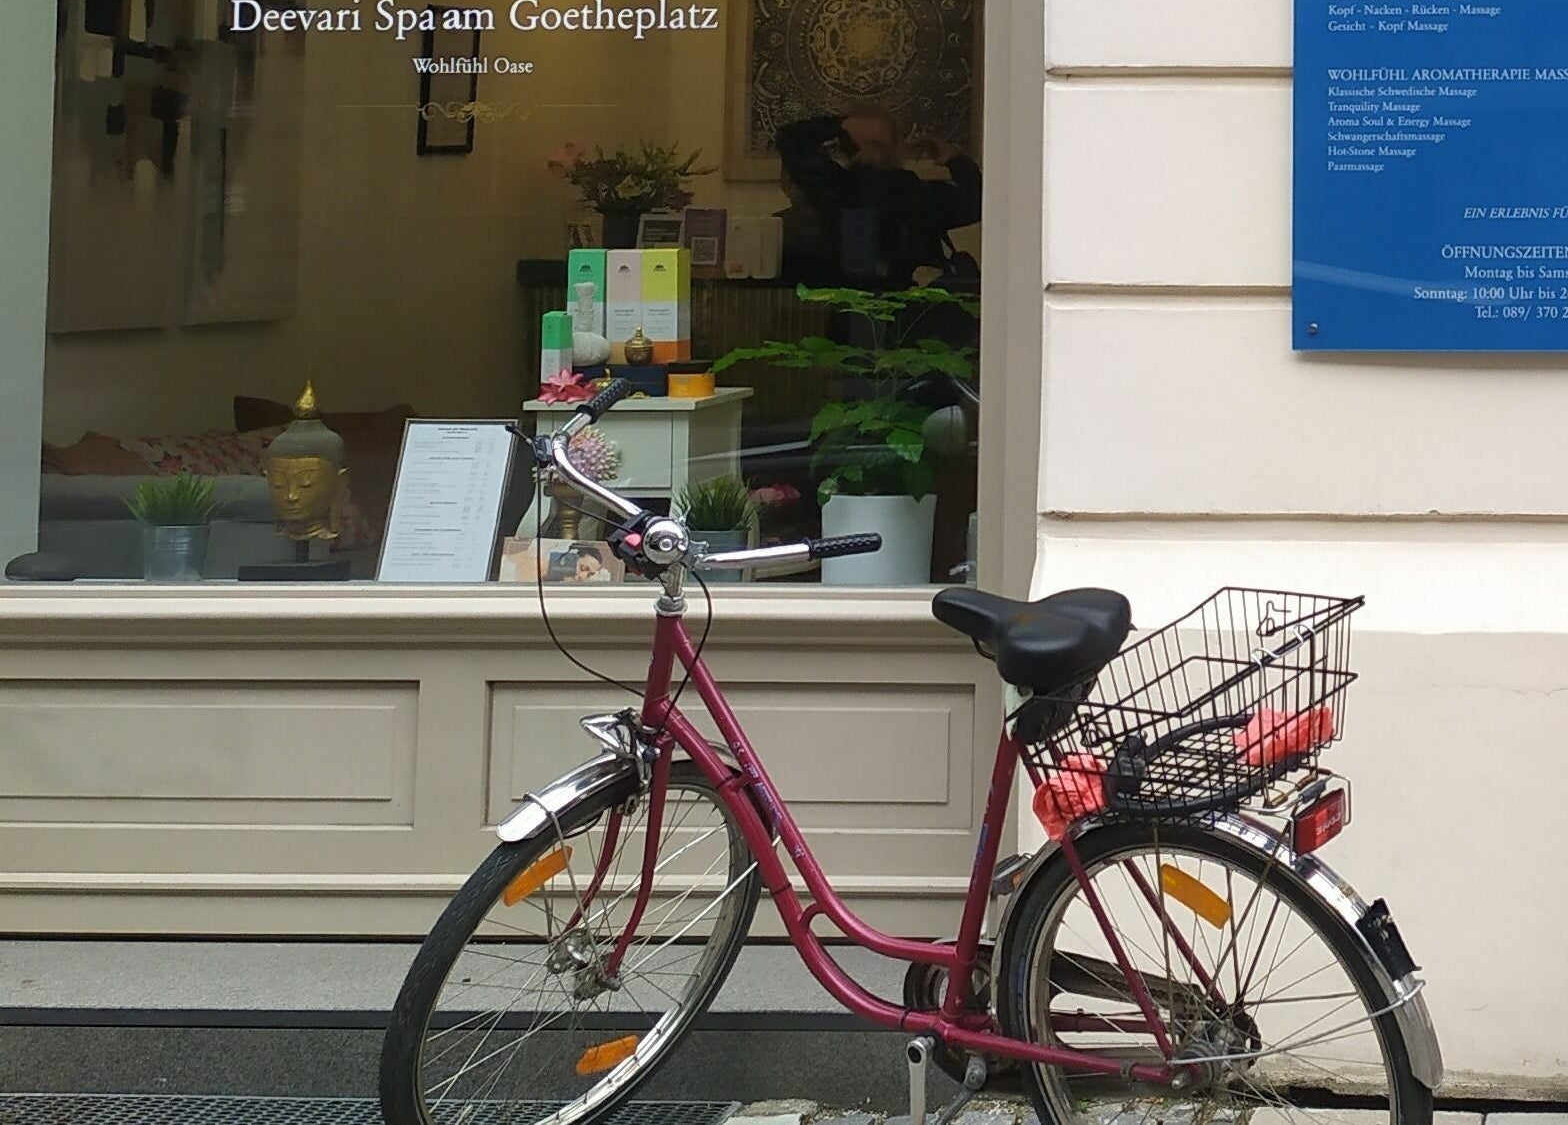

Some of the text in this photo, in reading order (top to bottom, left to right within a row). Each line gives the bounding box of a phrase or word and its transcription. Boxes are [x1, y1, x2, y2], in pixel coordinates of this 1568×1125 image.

[1329, 5, 1501, 16] Kopf Nacken Rücken Massage
[441, 5, 495, 32] am
[1328, 21, 1448, 33] Gesicht Kopf Massage
[412, 56, 534, 75] Wohlfühl Oase
[1328, 68, 1408, 80] WOHLFÜHL
[1412, 69, 1530, 80] AROMATHERAPIE
[1329, 86, 1477, 98] Klassische Schwedische Massage
[1328, 116, 1471, 128] Aroma Soul & Energy Massage
[1328, 161, 1384, 172] Paarmassage
[1464, 208, 1487, 218] EIN
[1490, 208, 1550, 218] ERLEBNIS
[1465, 267, 1513, 281] Montag
[1517, 266, 1534, 278] bis
[1414, 287, 1467, 302] Sonntag:
[1473, 287, 1504, 299] 10:00
[1509, 287, 1534, 299] Uhr
[1539, 287, 1555, 299] bis
[1537, 307, 1558, 318] 370
